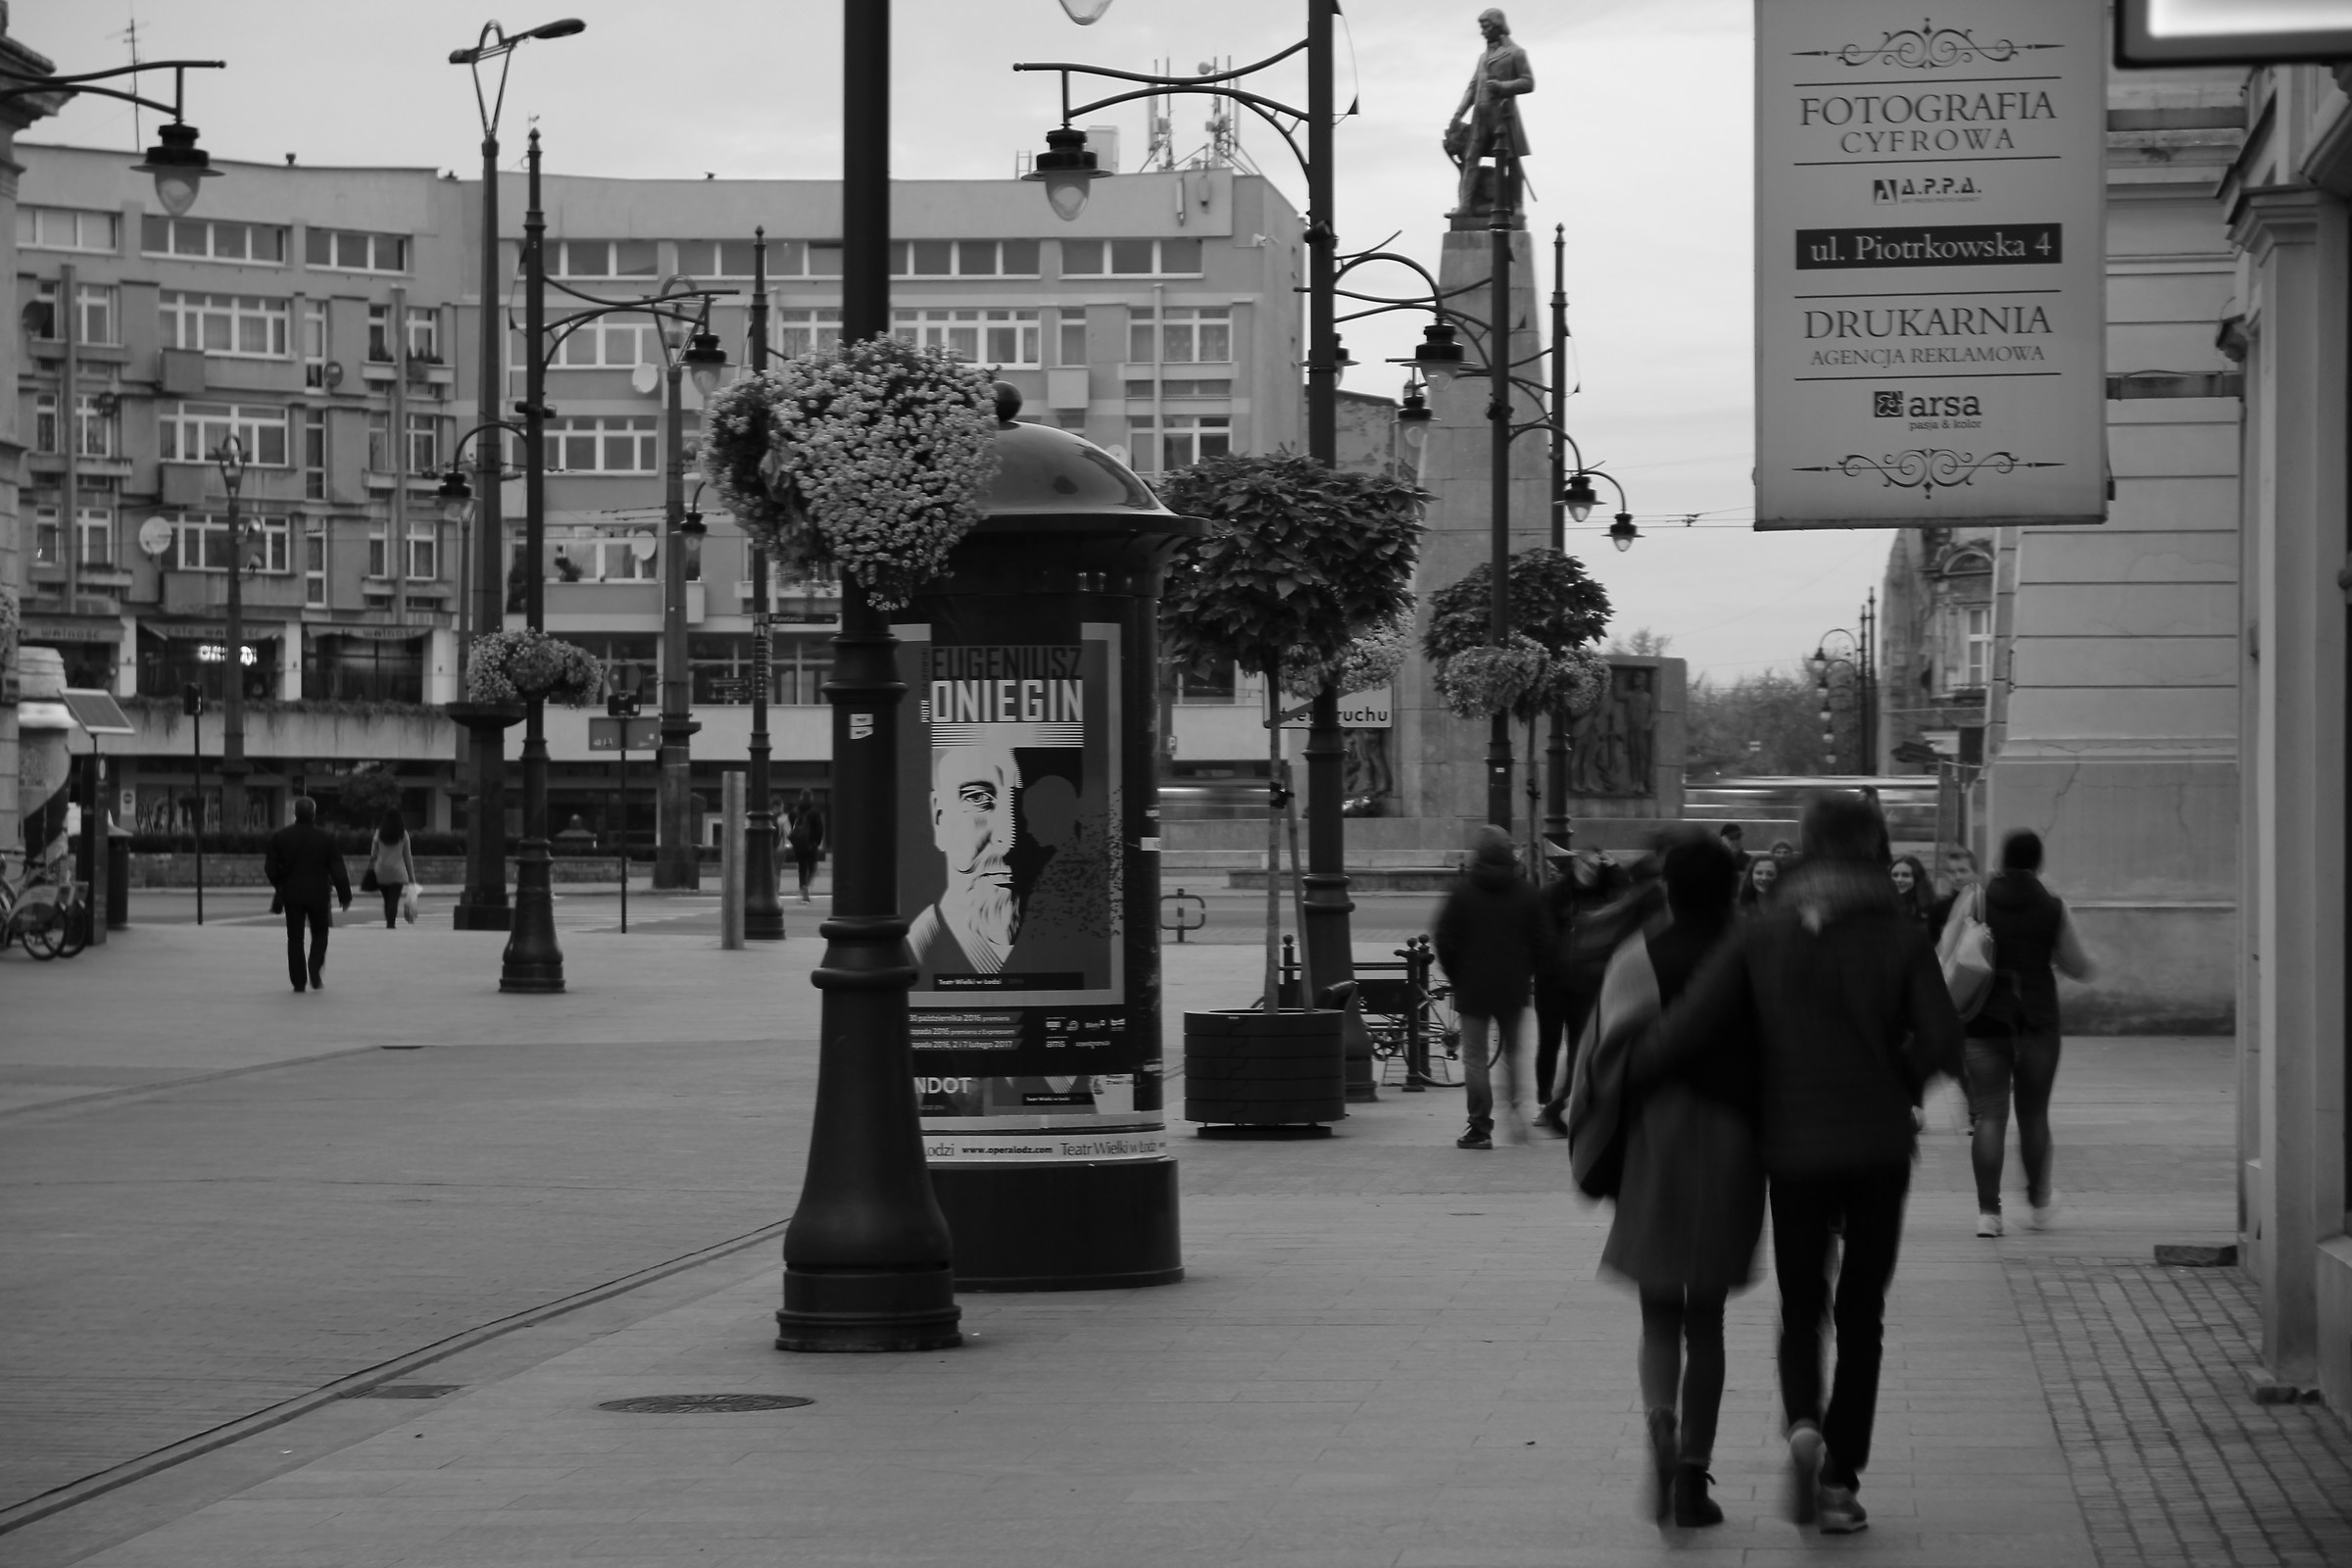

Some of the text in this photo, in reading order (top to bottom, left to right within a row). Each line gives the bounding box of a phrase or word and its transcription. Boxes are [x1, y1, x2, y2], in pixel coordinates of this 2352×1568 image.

[1800, 91, 2056, 125] FOTOGRAFIA
[1840, 127, 2016, 154] CYFROWA
[1811, 231, 2052, 263] ul. Piotrkowska 4
[1803, 306, 2054, 339] DRUKARNIA
[1810, 345, 2045, 368] AGENCJA REKLAMOWA
[1909, 393, 1983, 417] arsa
[1953, 419, 1983, 429] kolor
[932, 647, 1083, 679] EUGENIUSZ
[920, 700, 930, 723] PIOTR
[931, 679, 1084, 722] ONIEGIN
[924, 1143, 955, 1157] odzi
[1060, 1142, 1093, 1156] Teatr
[1094, 1140, 1129, 1155] Wielki
